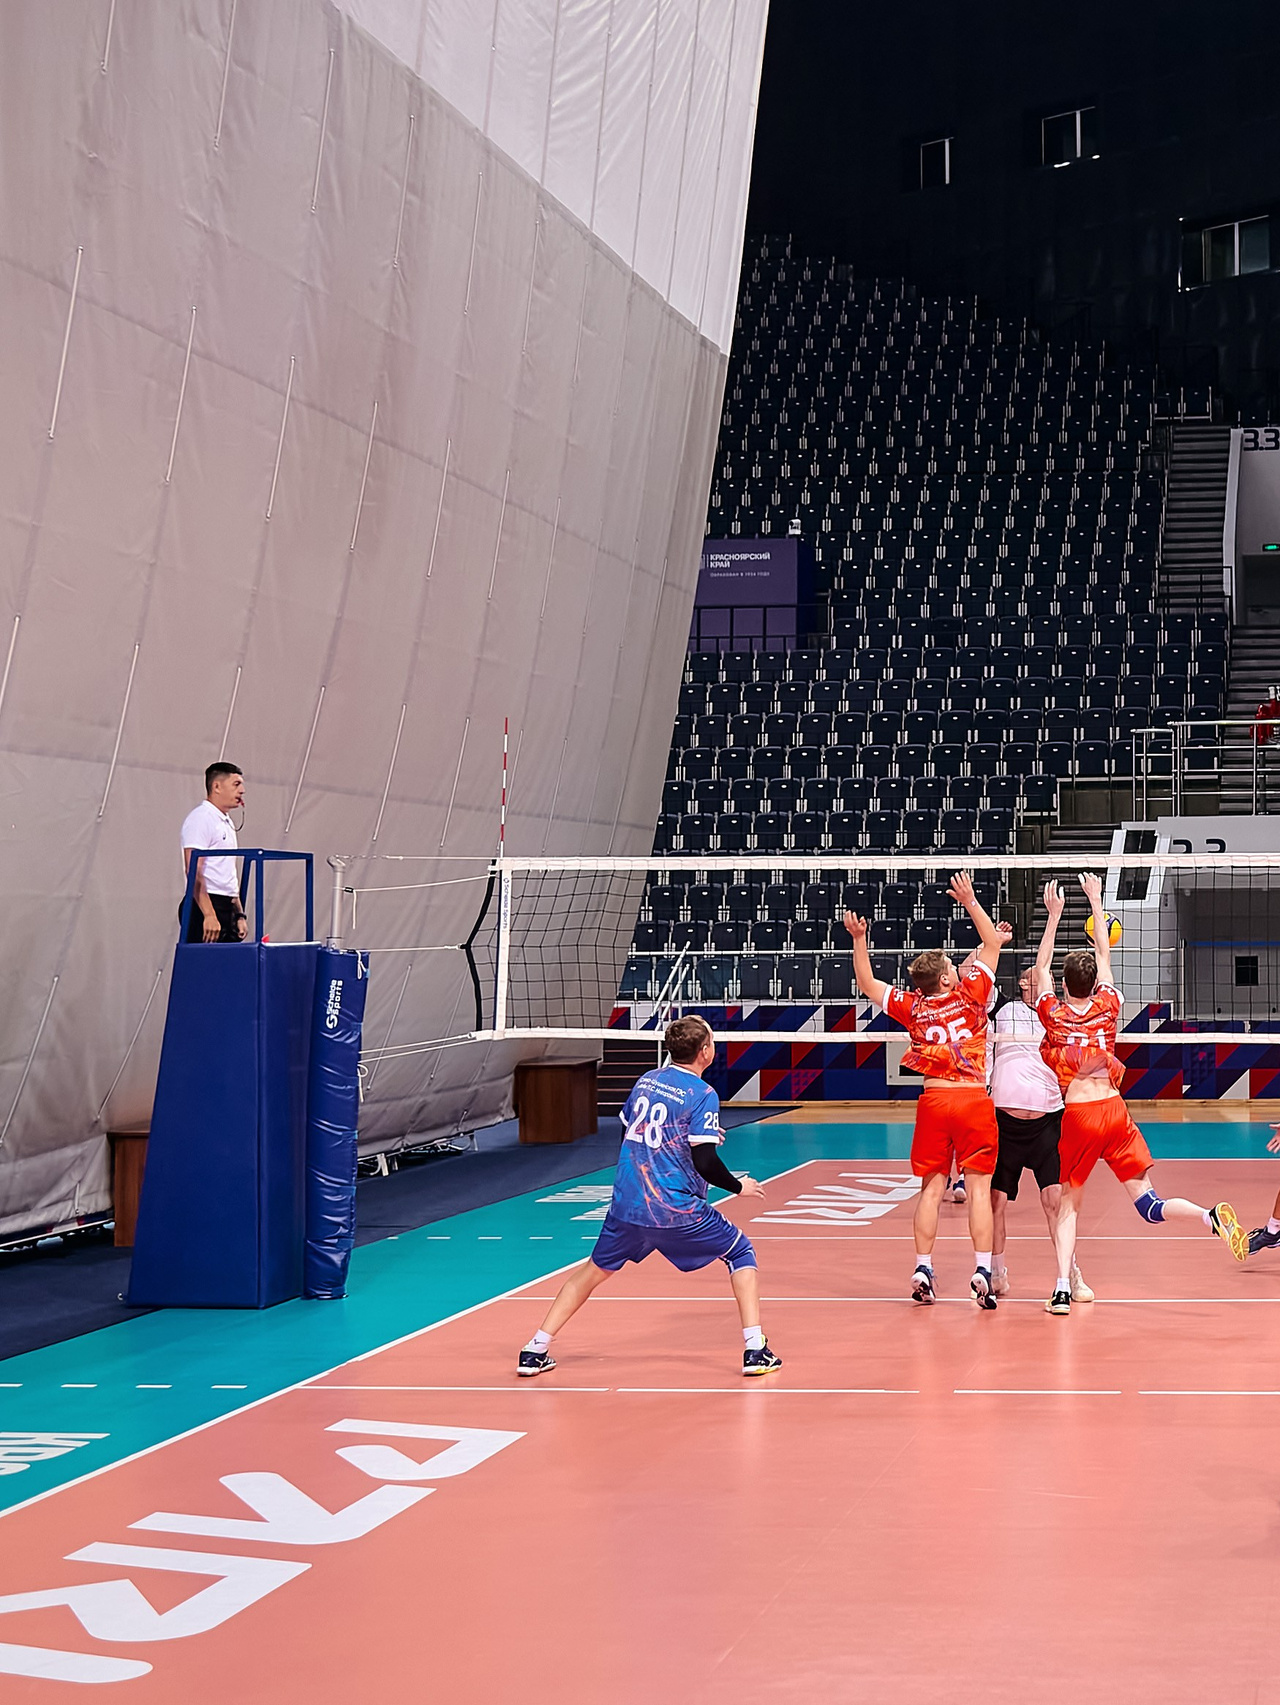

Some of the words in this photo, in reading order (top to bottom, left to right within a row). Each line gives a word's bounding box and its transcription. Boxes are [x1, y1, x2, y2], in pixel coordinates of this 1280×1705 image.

[710, 552, 771, 561] КРАСНОЯРСКИЙ
[326, 979, 337, 1015] Schelde
[626, 1096, 668, 1149] 28
[703, 1111, 719, 1131] 28
